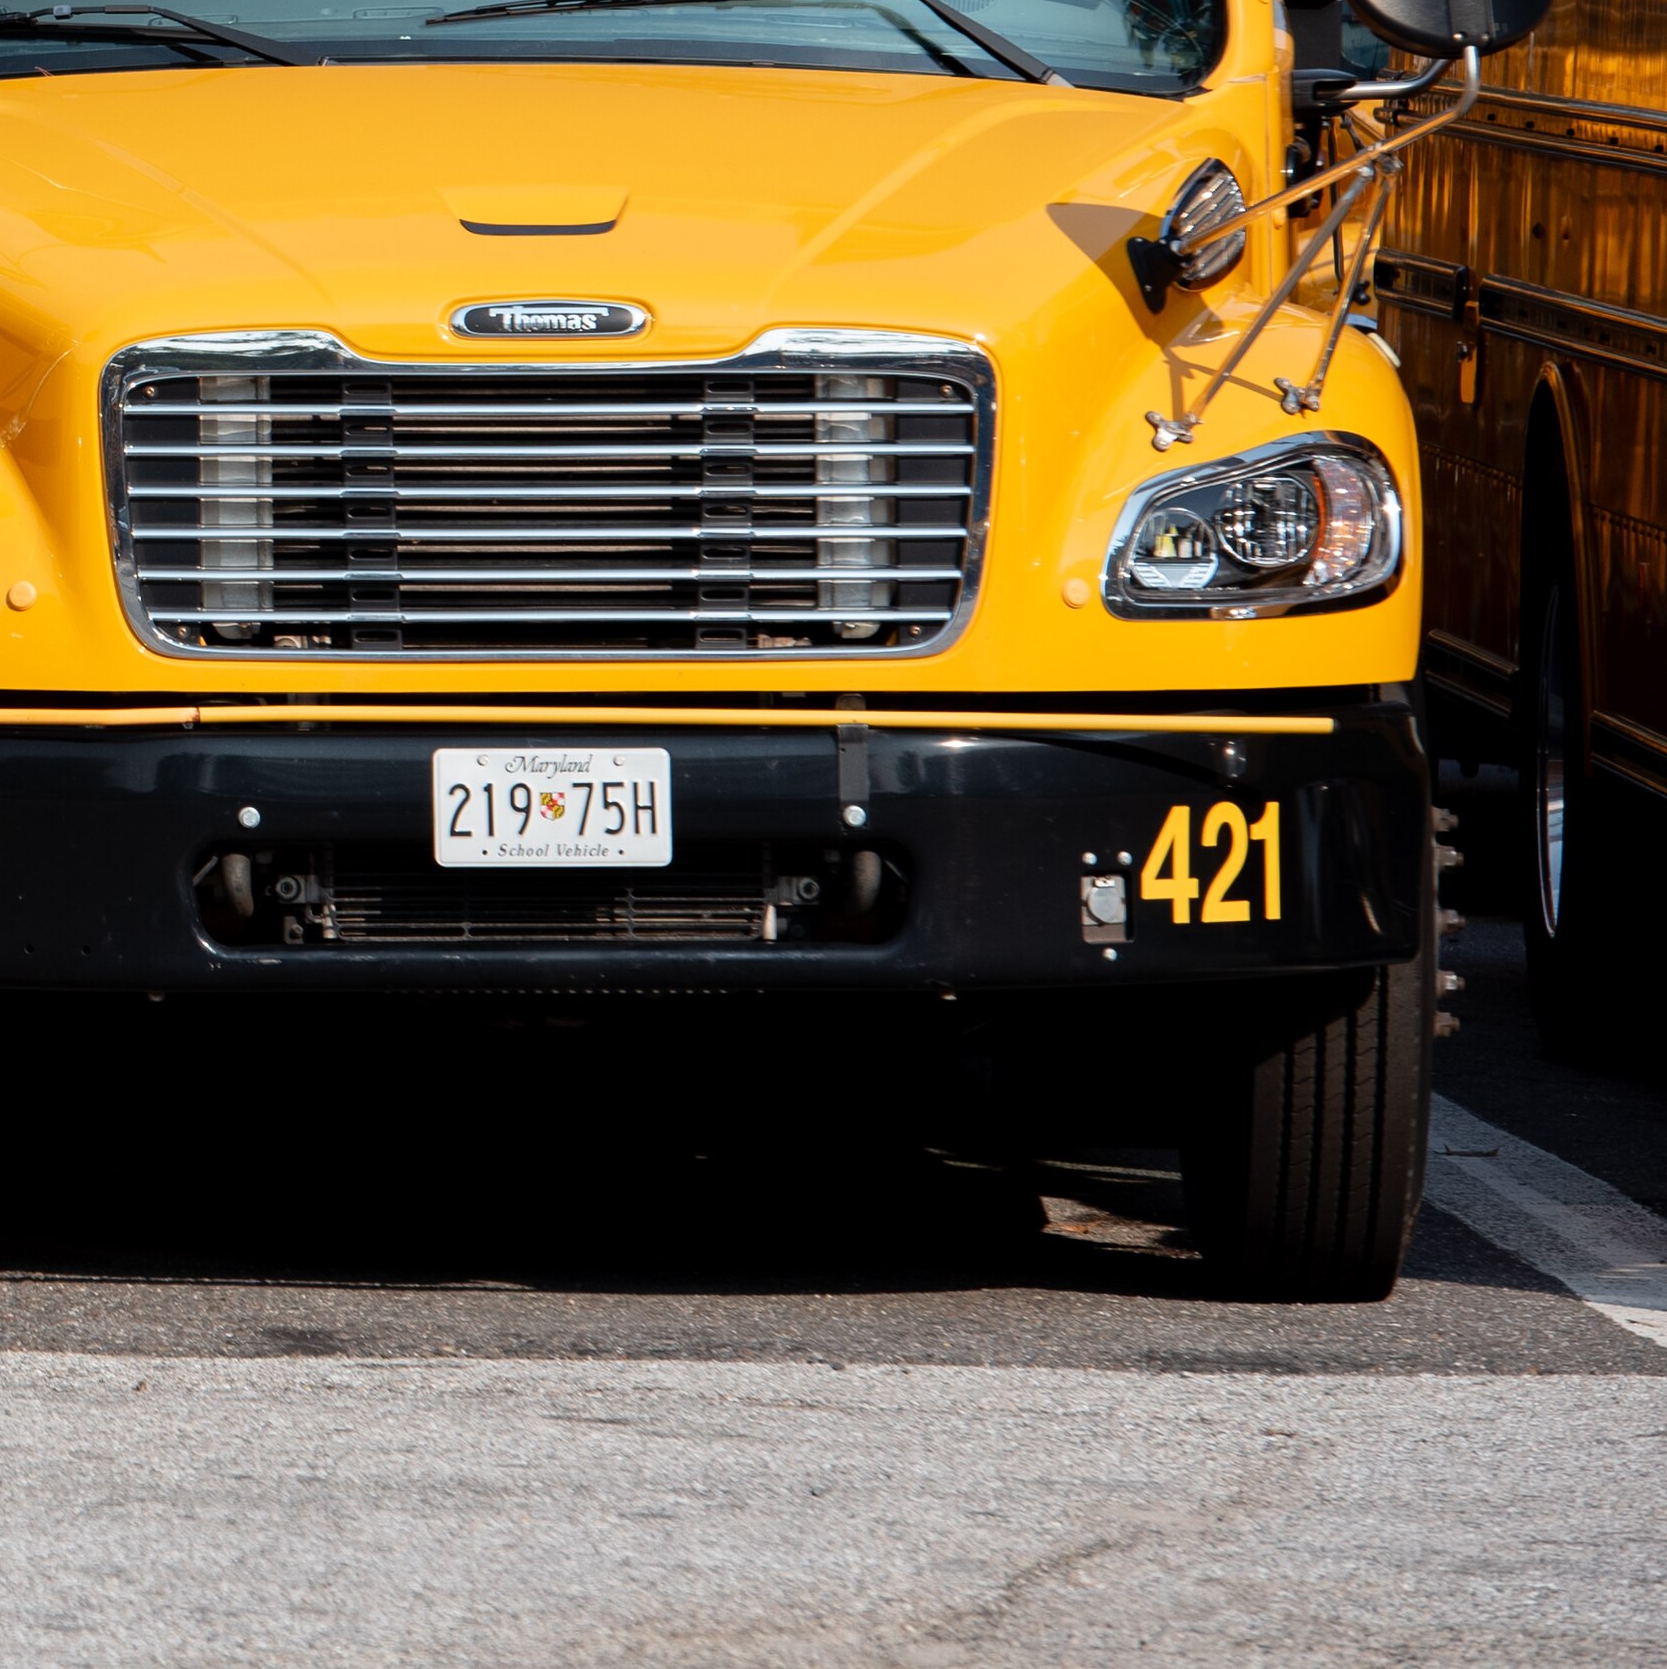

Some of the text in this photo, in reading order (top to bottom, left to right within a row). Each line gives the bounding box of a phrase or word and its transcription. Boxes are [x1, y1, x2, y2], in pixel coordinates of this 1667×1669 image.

[488, 306, 609, 331] Thomas
[505, 753, 594, 780] Maryland
[449, 781, 658, 837] 219 75H
[497, 843, 610, 858] School Vehicle
[1140, 801, 1282, 924] 421
